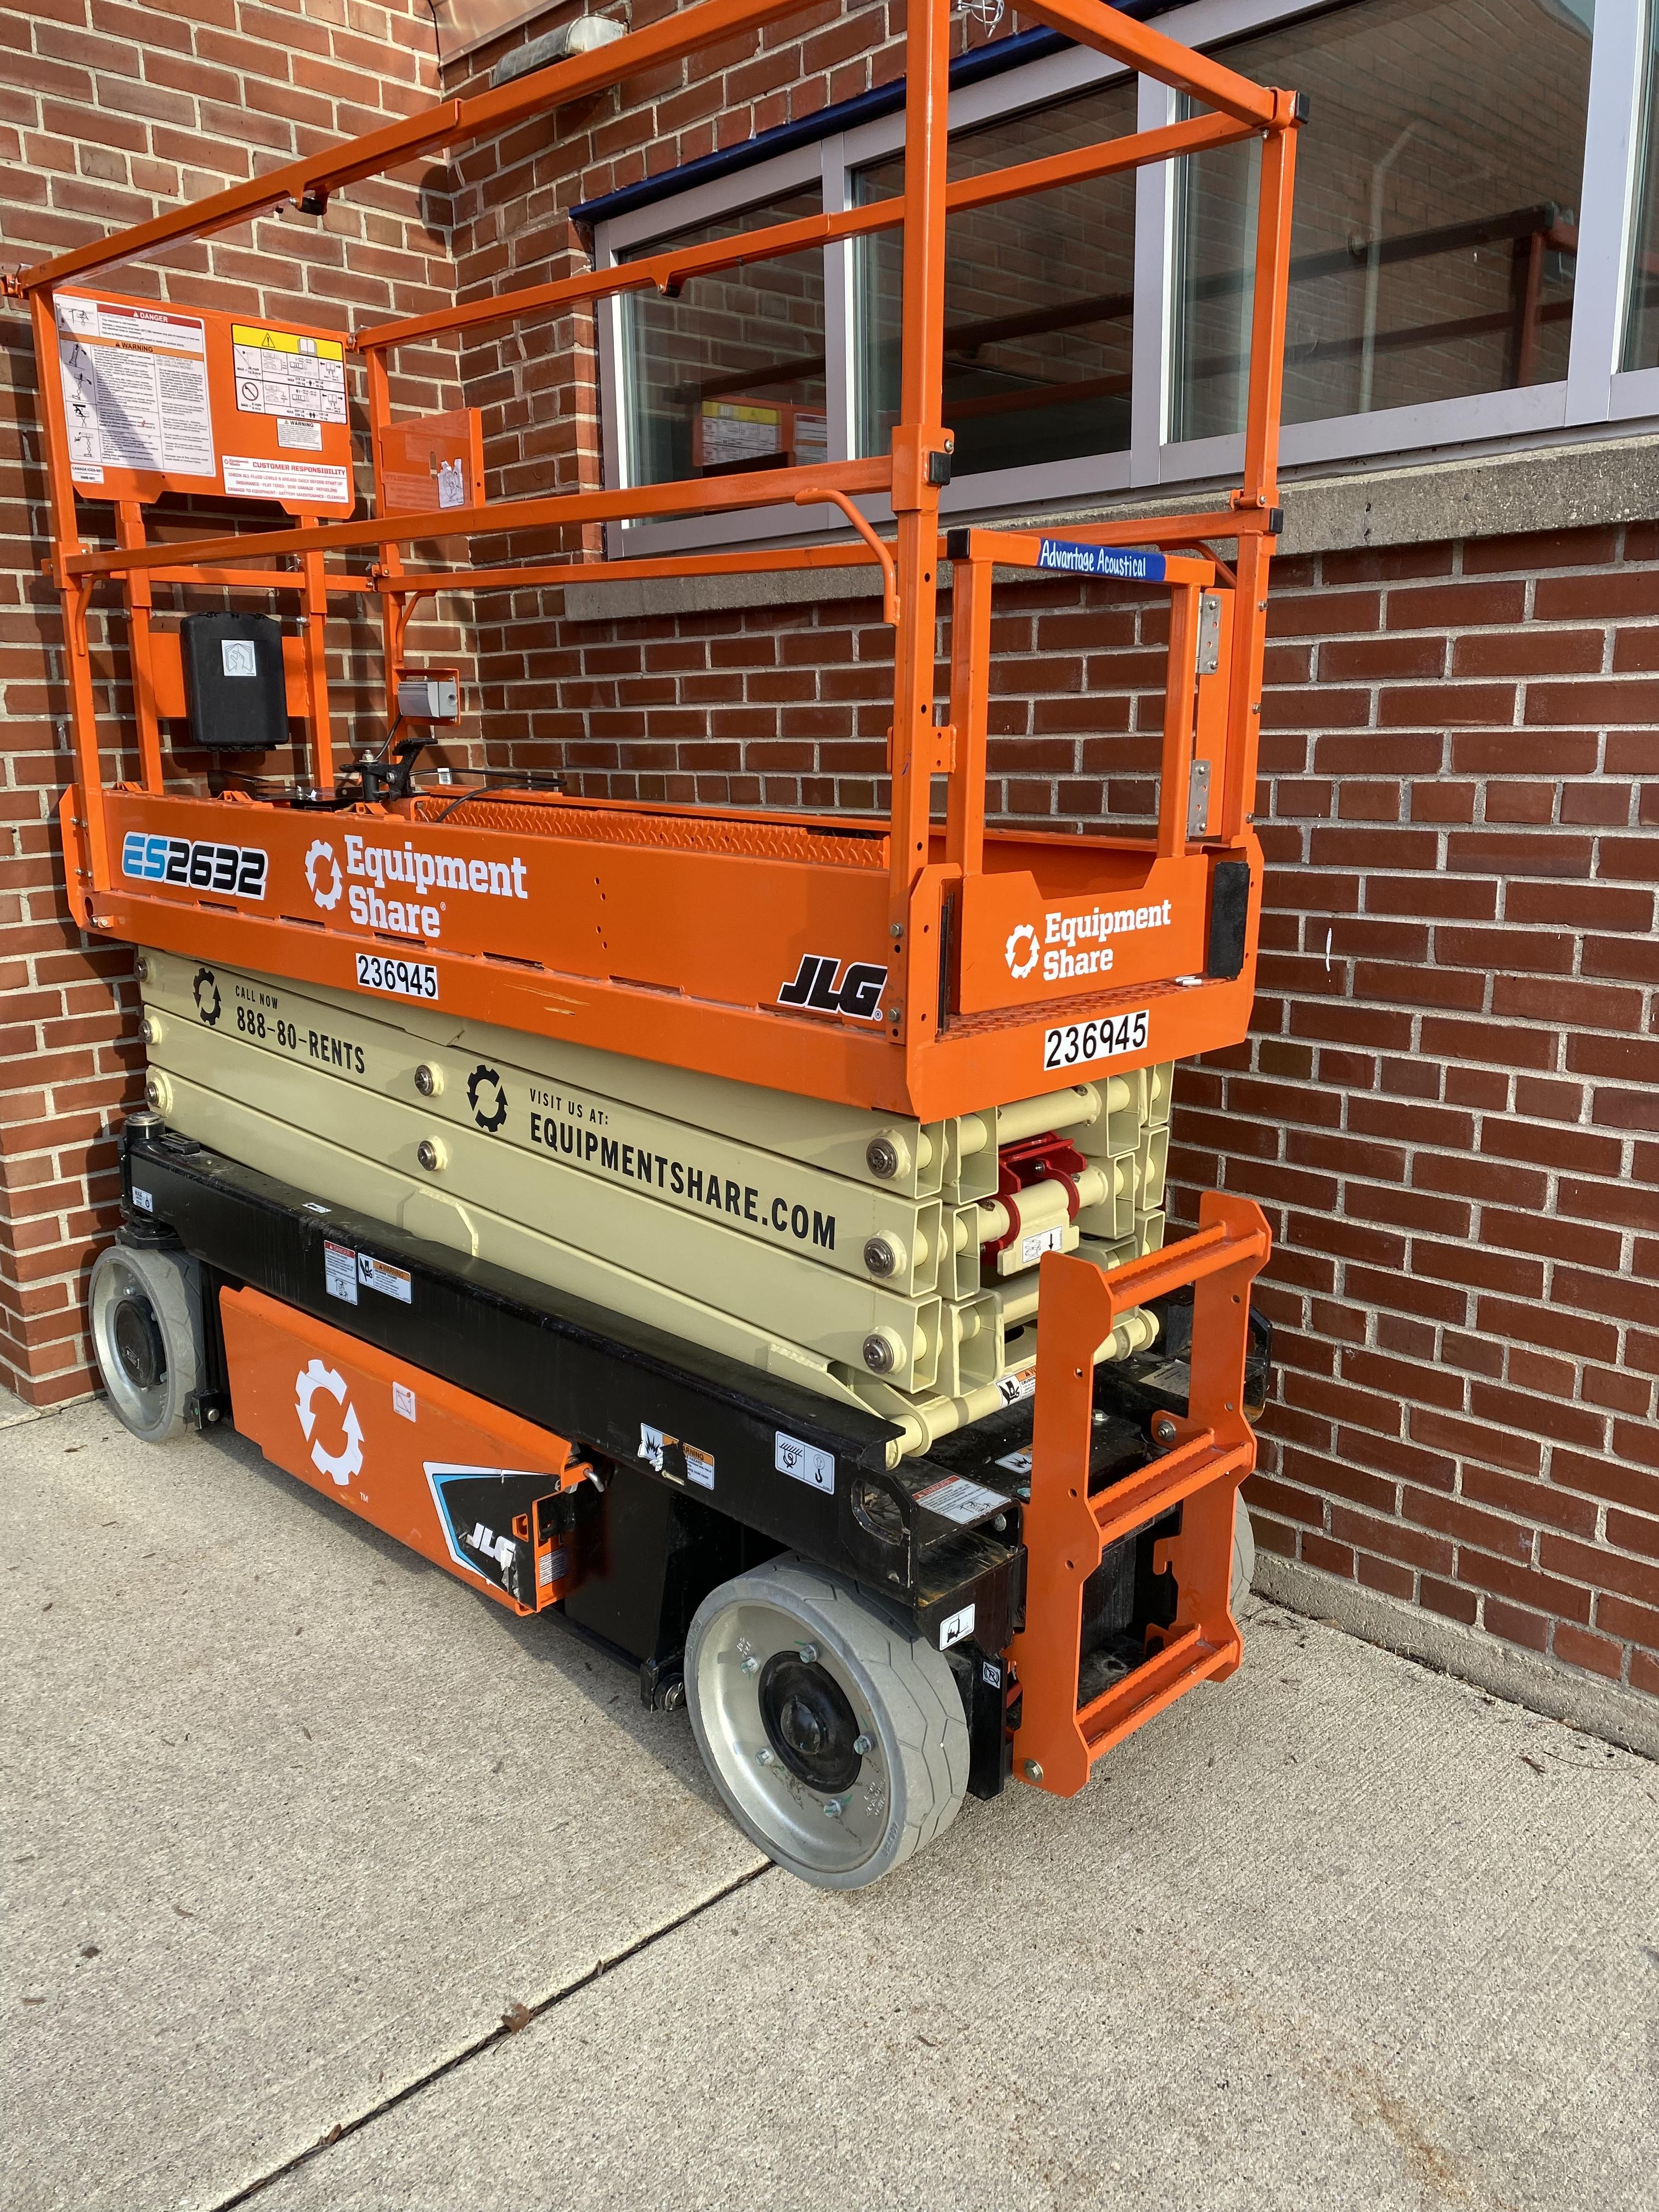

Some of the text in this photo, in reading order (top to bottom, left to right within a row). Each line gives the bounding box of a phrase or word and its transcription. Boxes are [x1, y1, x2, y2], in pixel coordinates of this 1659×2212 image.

[140, 312, 168, 323] DANGER
[121, 342, 153, 353] WARNING
[253, 462, 289, 471] CUSTOMER
[291, 465, 345, 475] RESPONSIBILITY
[1040, 540, 1146, 577] Advantage Acoustical
[124, 832, 266, 898] ES2632
[344, 834, 528, 898] Equipment
[347, 886, 440, 938] Share
[1046, 899, 1171, 944] Equipment
[358, 955, 436, 997] 236945
[1043, 948, 1113, 980] Share
[235, 985, 278, 1009] CALL NOW
[778, 954, 887, 1019] JLG
[236, 1006, 365, 1074] 888-80-RENTS
[1046, 1012, 1146, 1068] 236945
[530, 1088, 608, 1125] VISIT US AT:
[530, 1111, 836, 1250] EQUIPMENTSHARE.COM
[334, 1246, 350, 1256] DANGER
[383, 1265, 404, 1278] WARNING
[926, 1480, 953, 1494] DANGER
